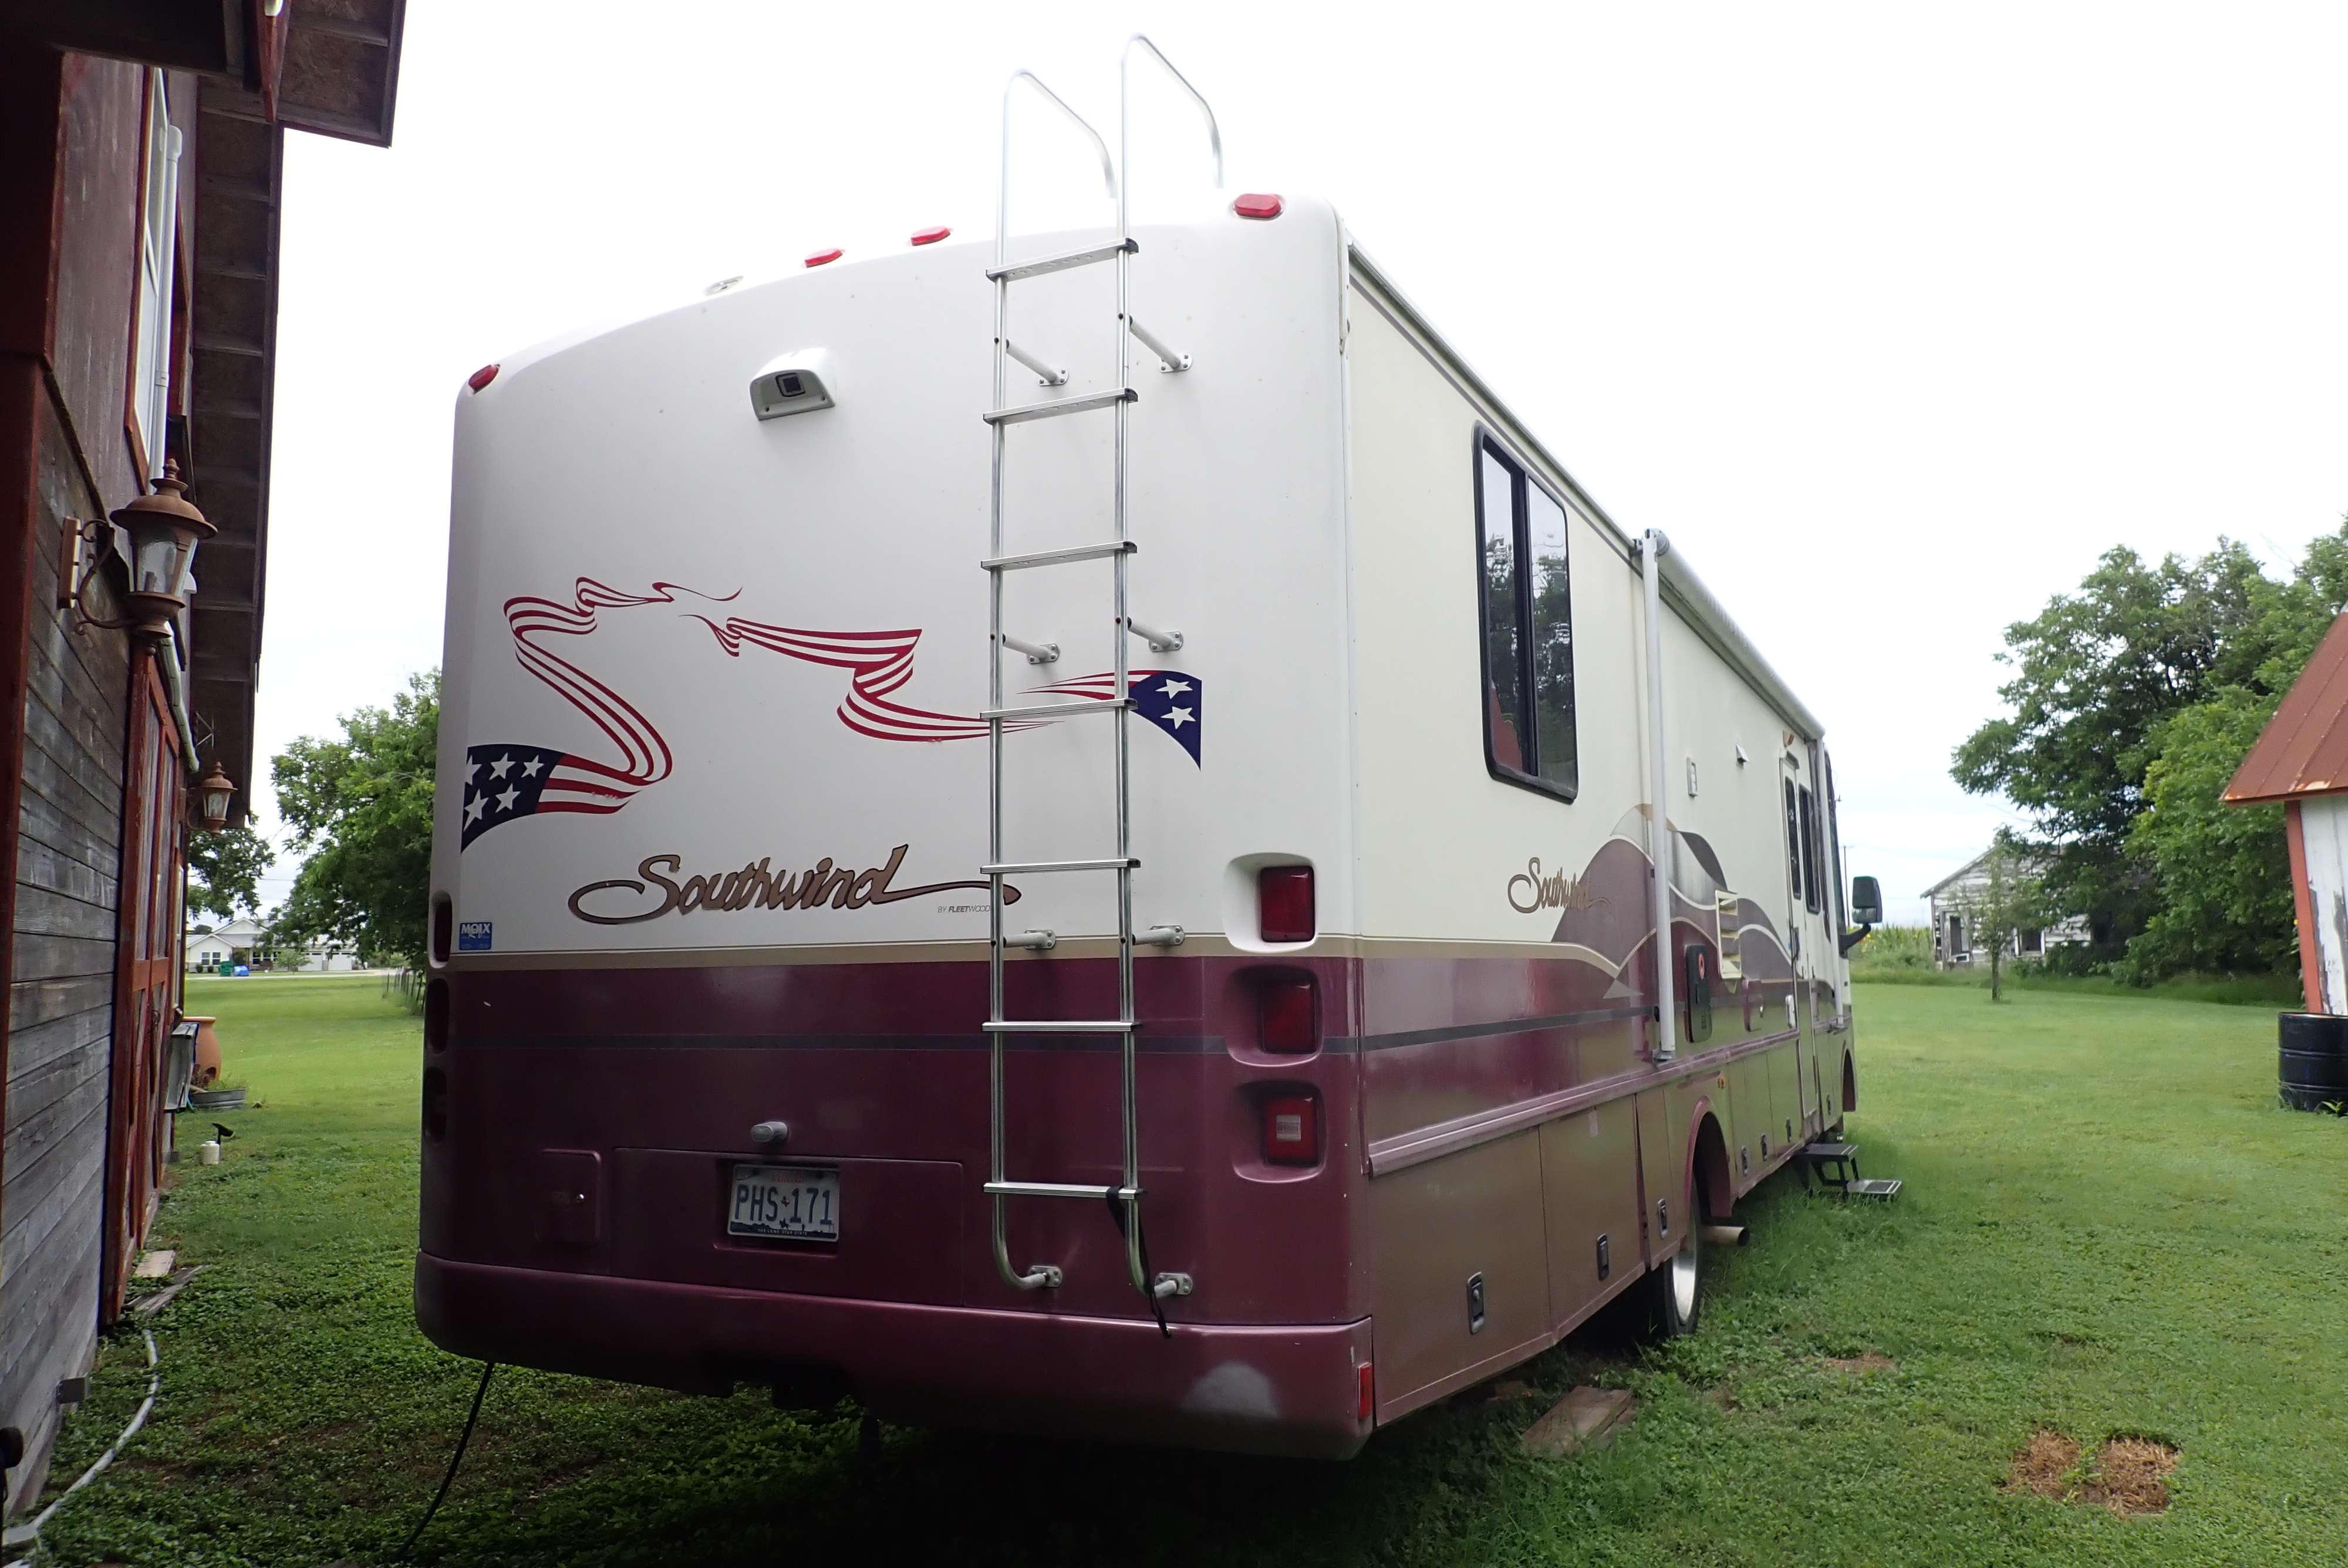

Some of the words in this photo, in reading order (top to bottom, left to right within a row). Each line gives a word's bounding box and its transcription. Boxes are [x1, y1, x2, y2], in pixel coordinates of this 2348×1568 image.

[567, 843, 1022, 925] Southwind
[948, 905, 991, 913] FLEETWOOD
[735, 1184, 778, 1221] PHS
[790, 1188, 832, 1225] 171
